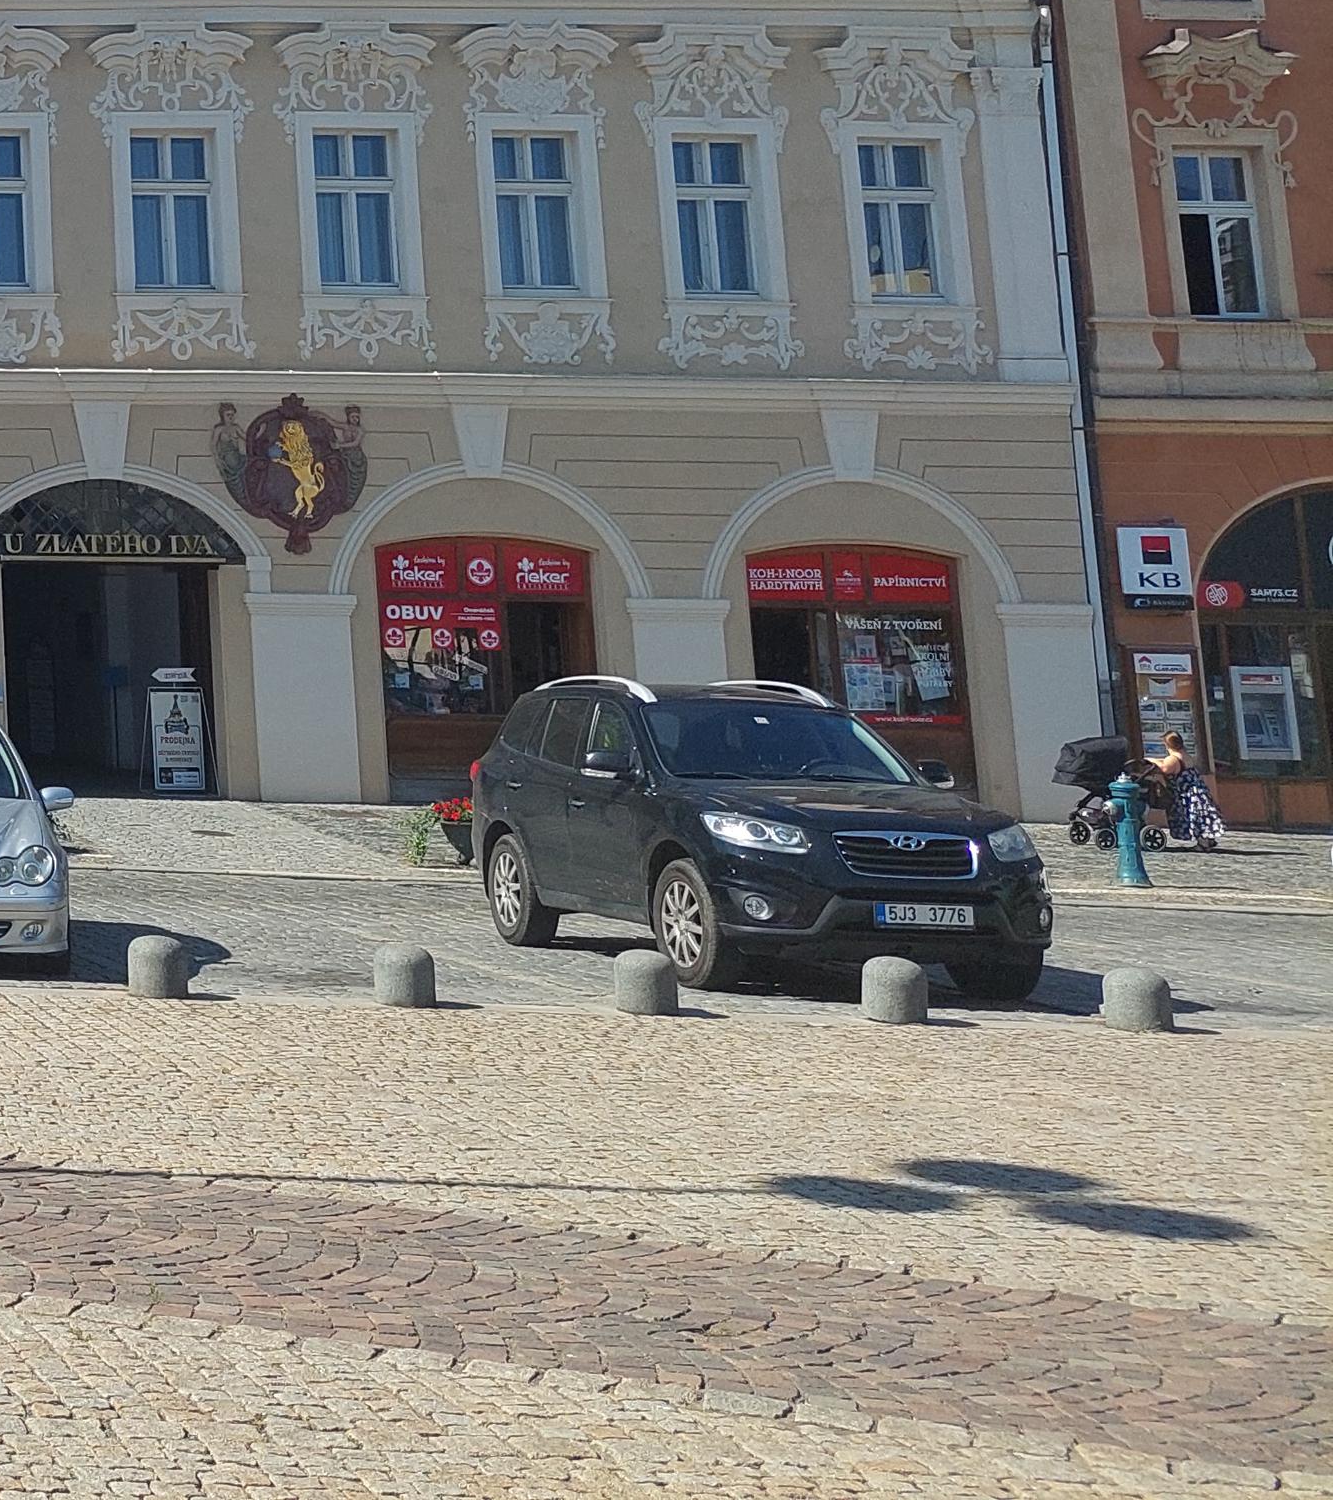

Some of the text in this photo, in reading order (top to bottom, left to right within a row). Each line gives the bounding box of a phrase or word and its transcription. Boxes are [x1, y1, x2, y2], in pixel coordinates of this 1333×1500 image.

[3, 530, 218, 556] U ZLATÉHO LVA
[391, 565, 445, 581] rieker
[516, 568, 570, 584] rieker
[748, 568, 822, 579] KOH-I-NOOR
[873, 574, 947, 588] PAPÍRNICTVÍ
[1138, 572, 1181, 589] KB
[749, 580, 824, 591] HARDTMUTH
[386, 604, 444, 620] OBUV
[844, 618, 943, 631] VÁŠEŇ Z TVOŘENÍ
[888, 906, 967, 923] 5J3 3776
